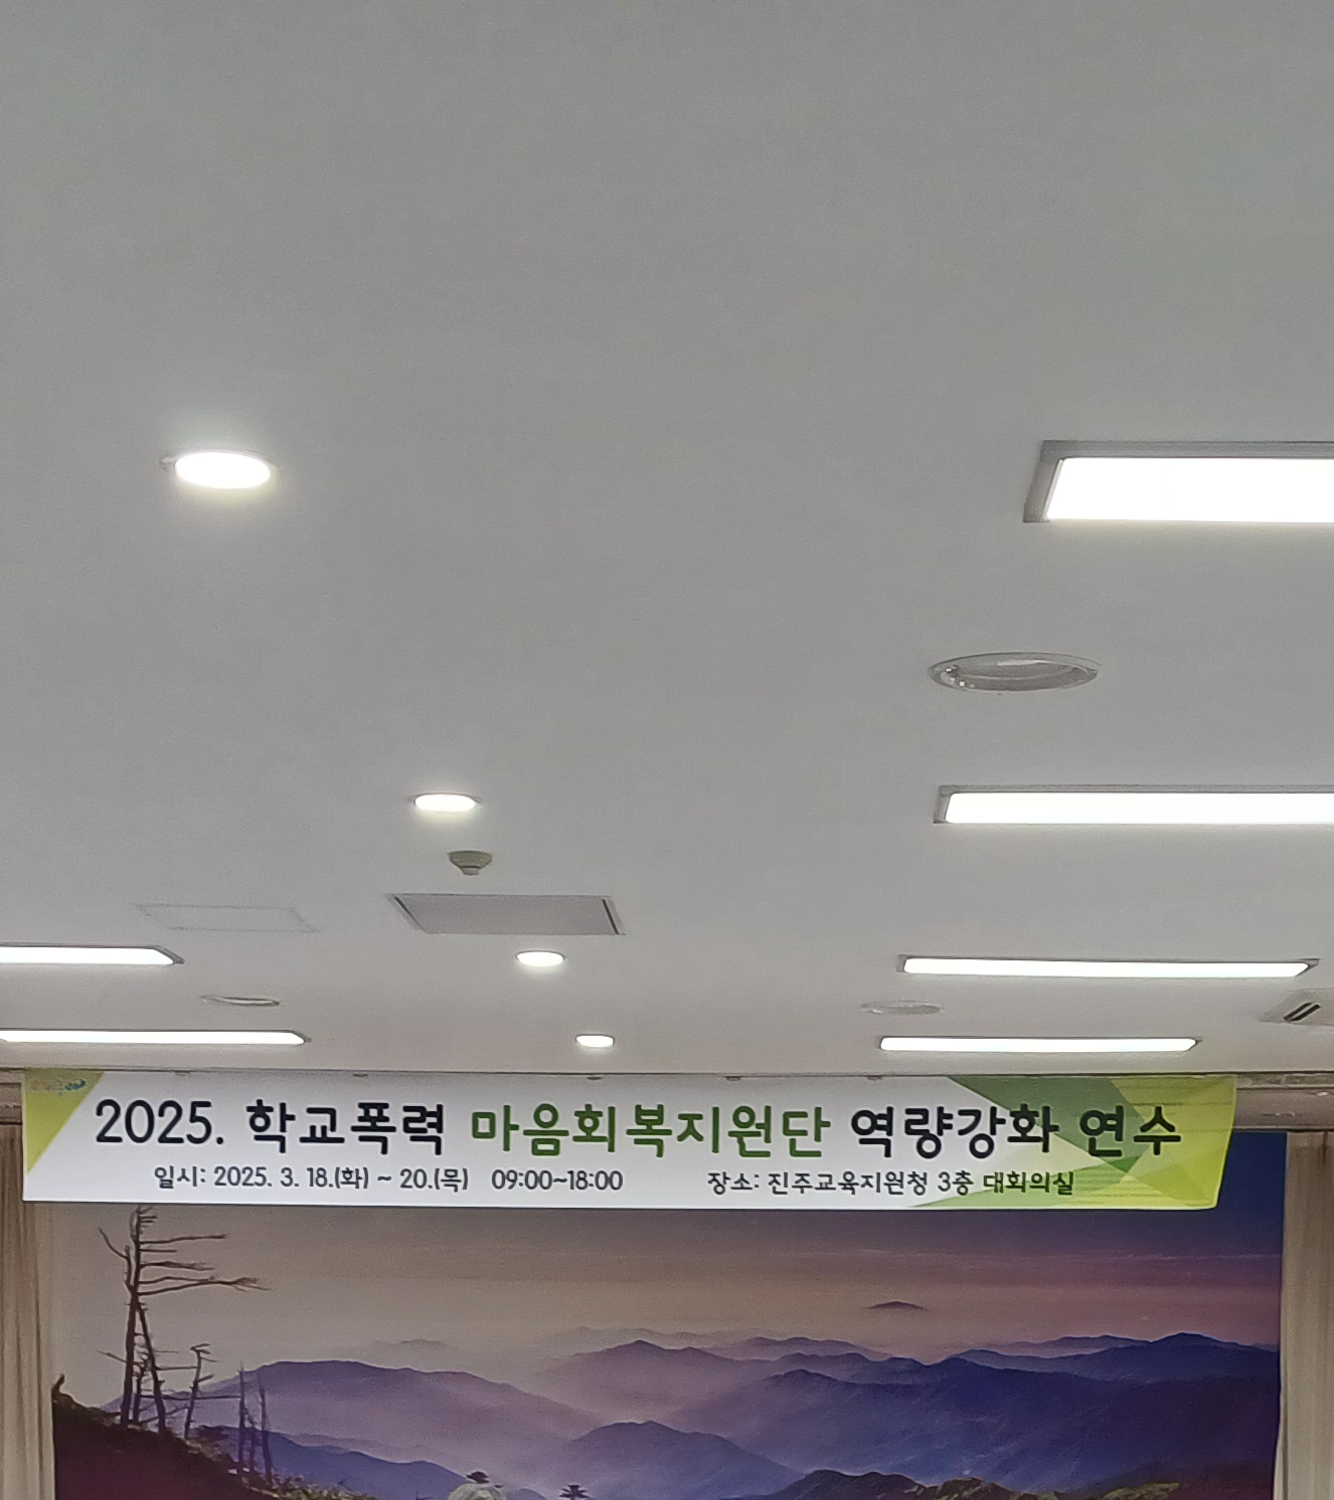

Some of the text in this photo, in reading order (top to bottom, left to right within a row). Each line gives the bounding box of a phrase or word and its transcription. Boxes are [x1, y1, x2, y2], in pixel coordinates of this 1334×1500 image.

[95, 1098, 1182, 1159] 2025. 학교폭력 마음회복지원단 역량강화 연수
[154, 1165, 206, 1190] 일시:
[213, 1165, 273, 1187] 2025.
[280, 1166, 300, 1187] 3.
[307, 1166, 370, 1190] 18.(화)
[400, 1167, 469, 1193] 20.(목)
[491, 1169, 624, 1191] 09:00~18:00
[707, 1171, 760, 1196] 장소:
[768, 1171, 928, 1196] 진주교육지원청
[937, 1171, 974, 1196] 3층
[983, 1170, 1074, 1196] 대회의실
